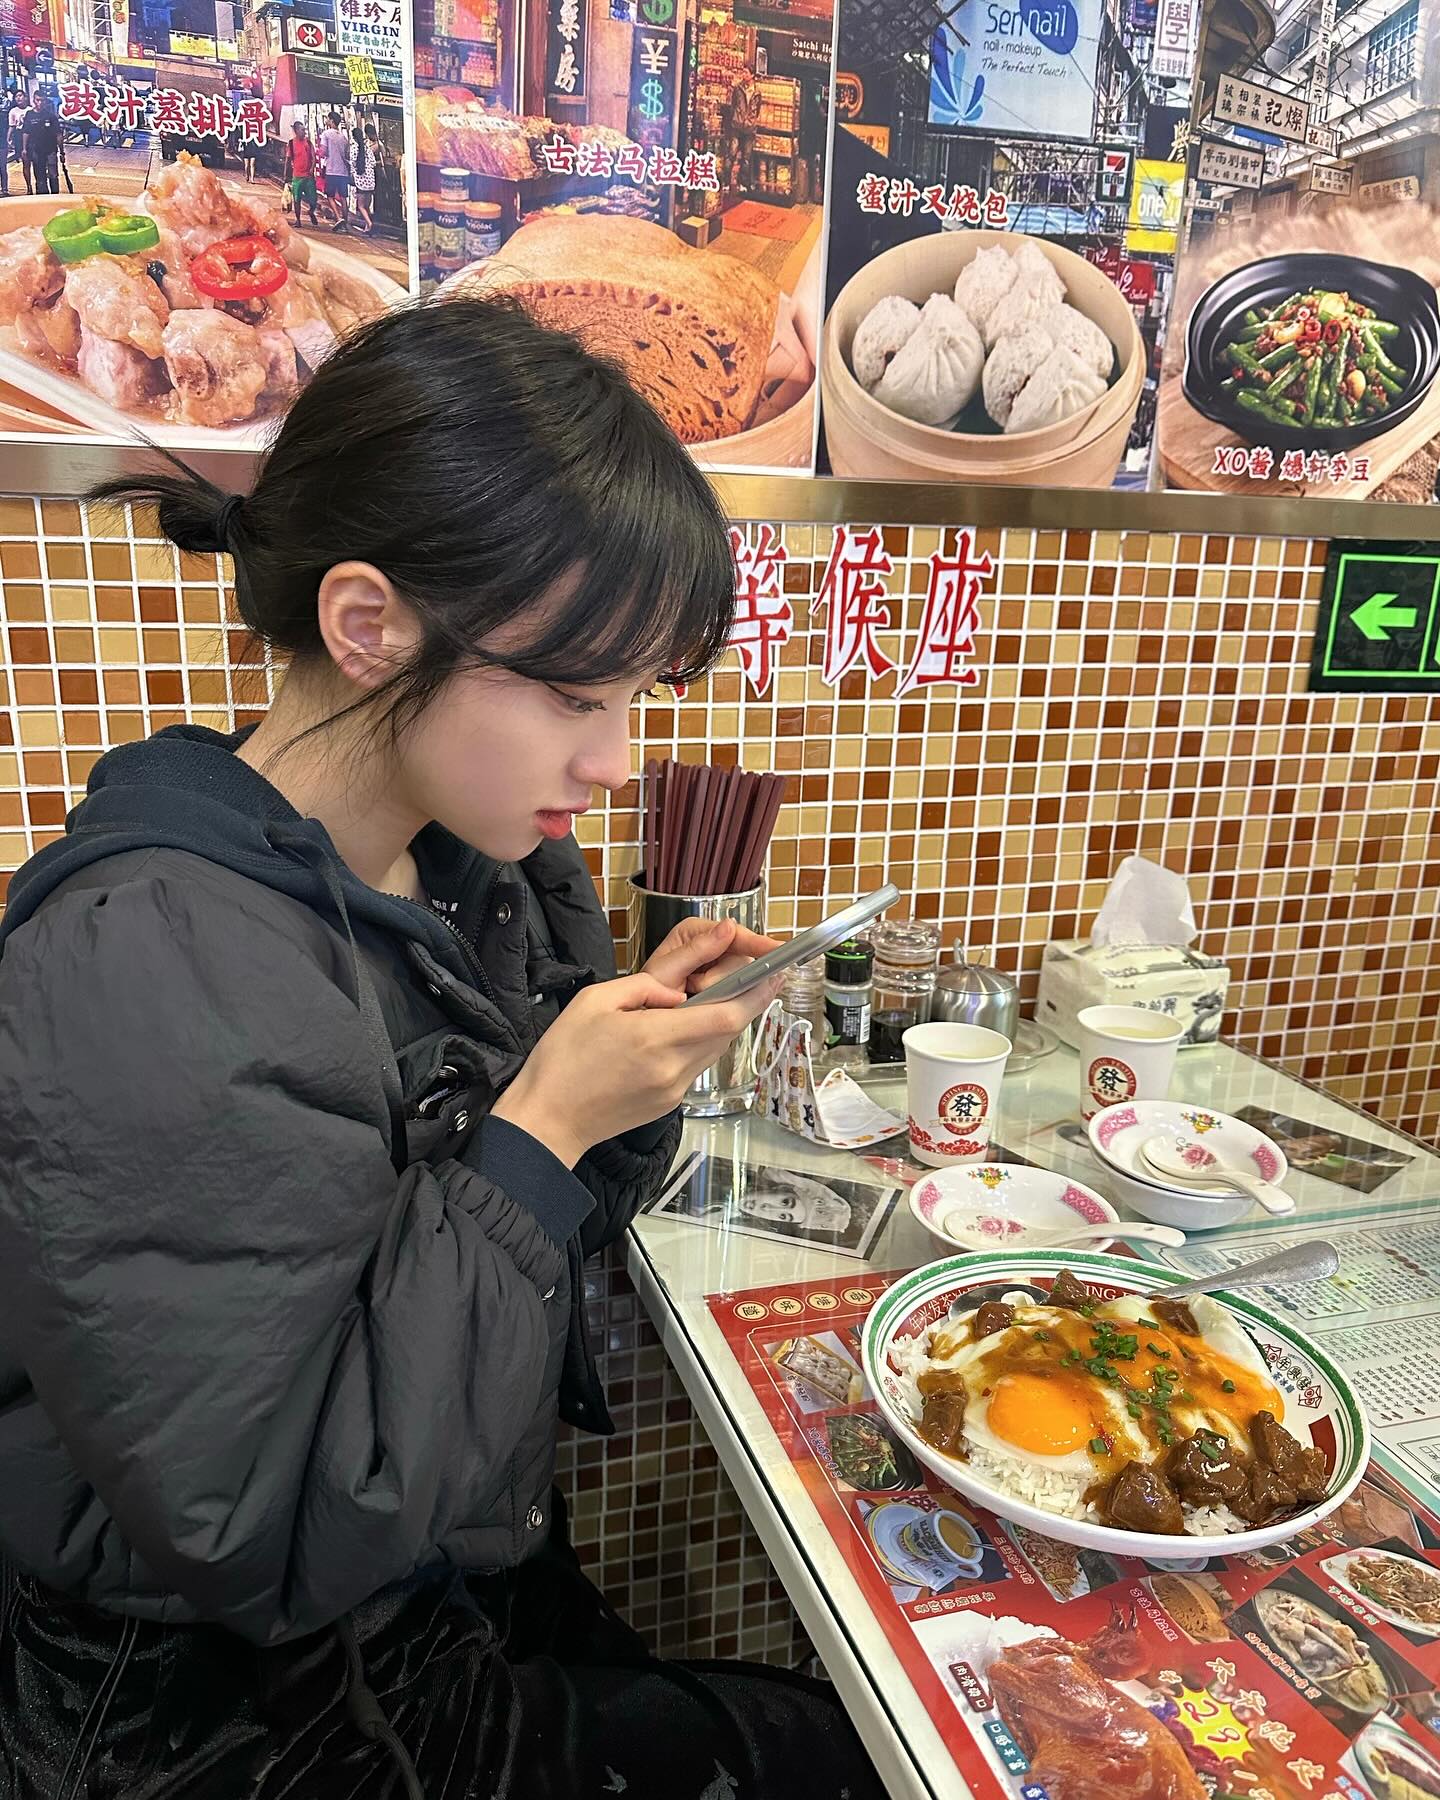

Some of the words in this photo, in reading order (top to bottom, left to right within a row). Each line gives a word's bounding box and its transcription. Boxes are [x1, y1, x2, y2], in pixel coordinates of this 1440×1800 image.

[340, 20, 400, 38] VIRGIN
[60, 83, 272, 145] 豉汁蒸排骨
[542, 135, 721, 191] 古法马拉糕
[668, 524, 994, 699] 等候座
[907, 1283, 981, 1333] 年兴发茶
